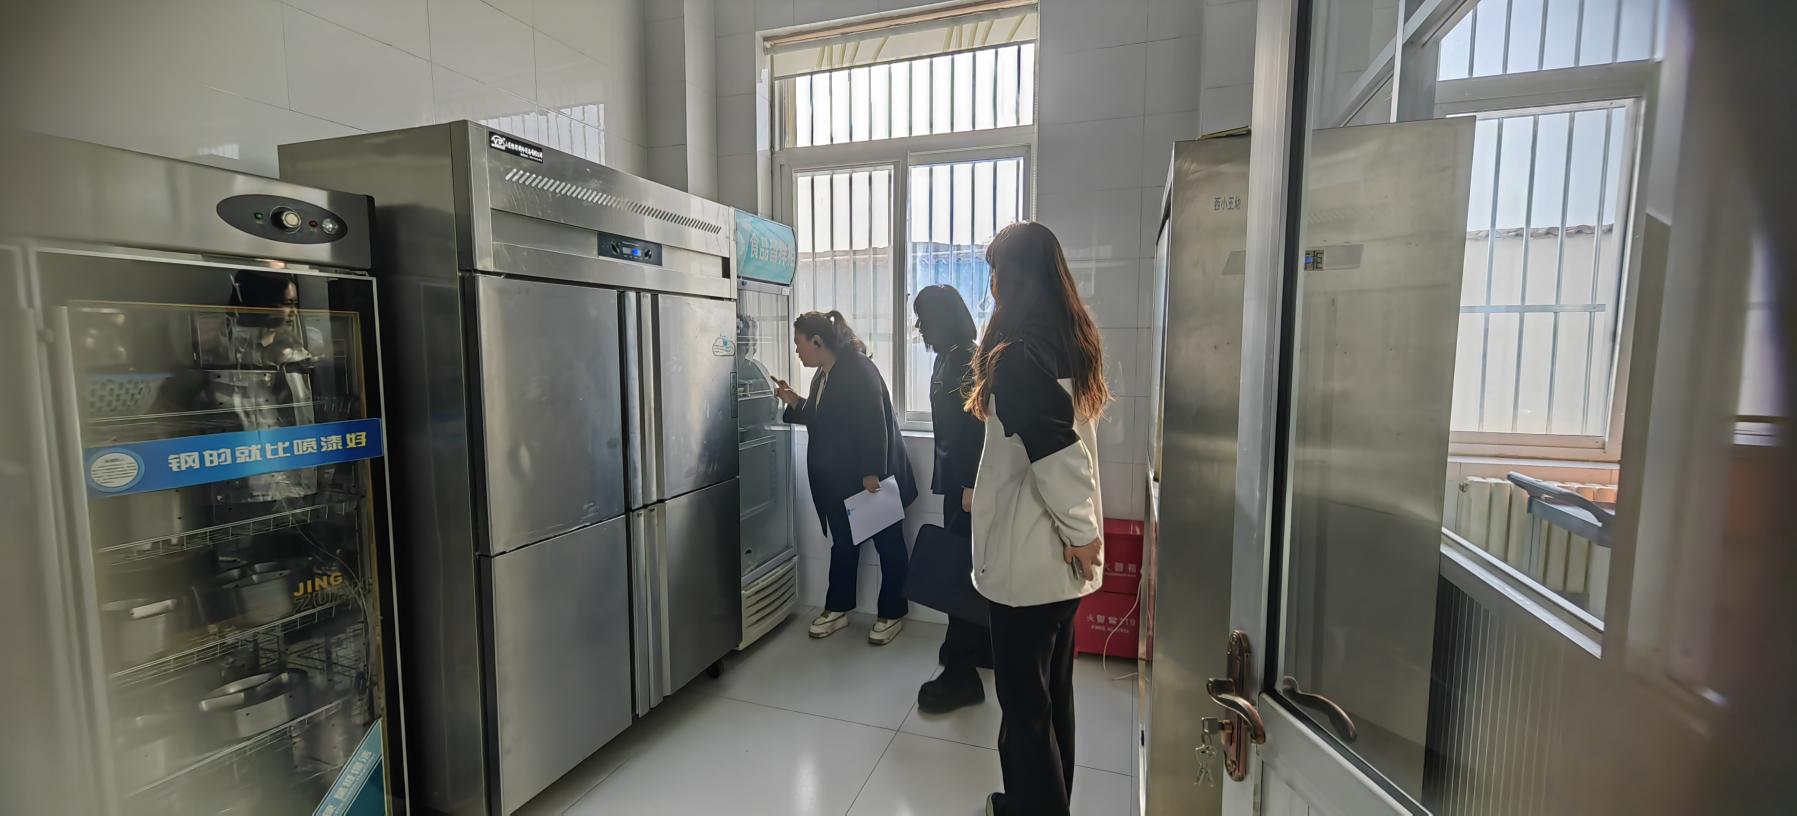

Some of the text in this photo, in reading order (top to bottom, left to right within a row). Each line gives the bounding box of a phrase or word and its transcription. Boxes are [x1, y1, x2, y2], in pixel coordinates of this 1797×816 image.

[167, 431, 368, 473] 钢的就比喷漆好
[293, 570, 344, 598] JING
